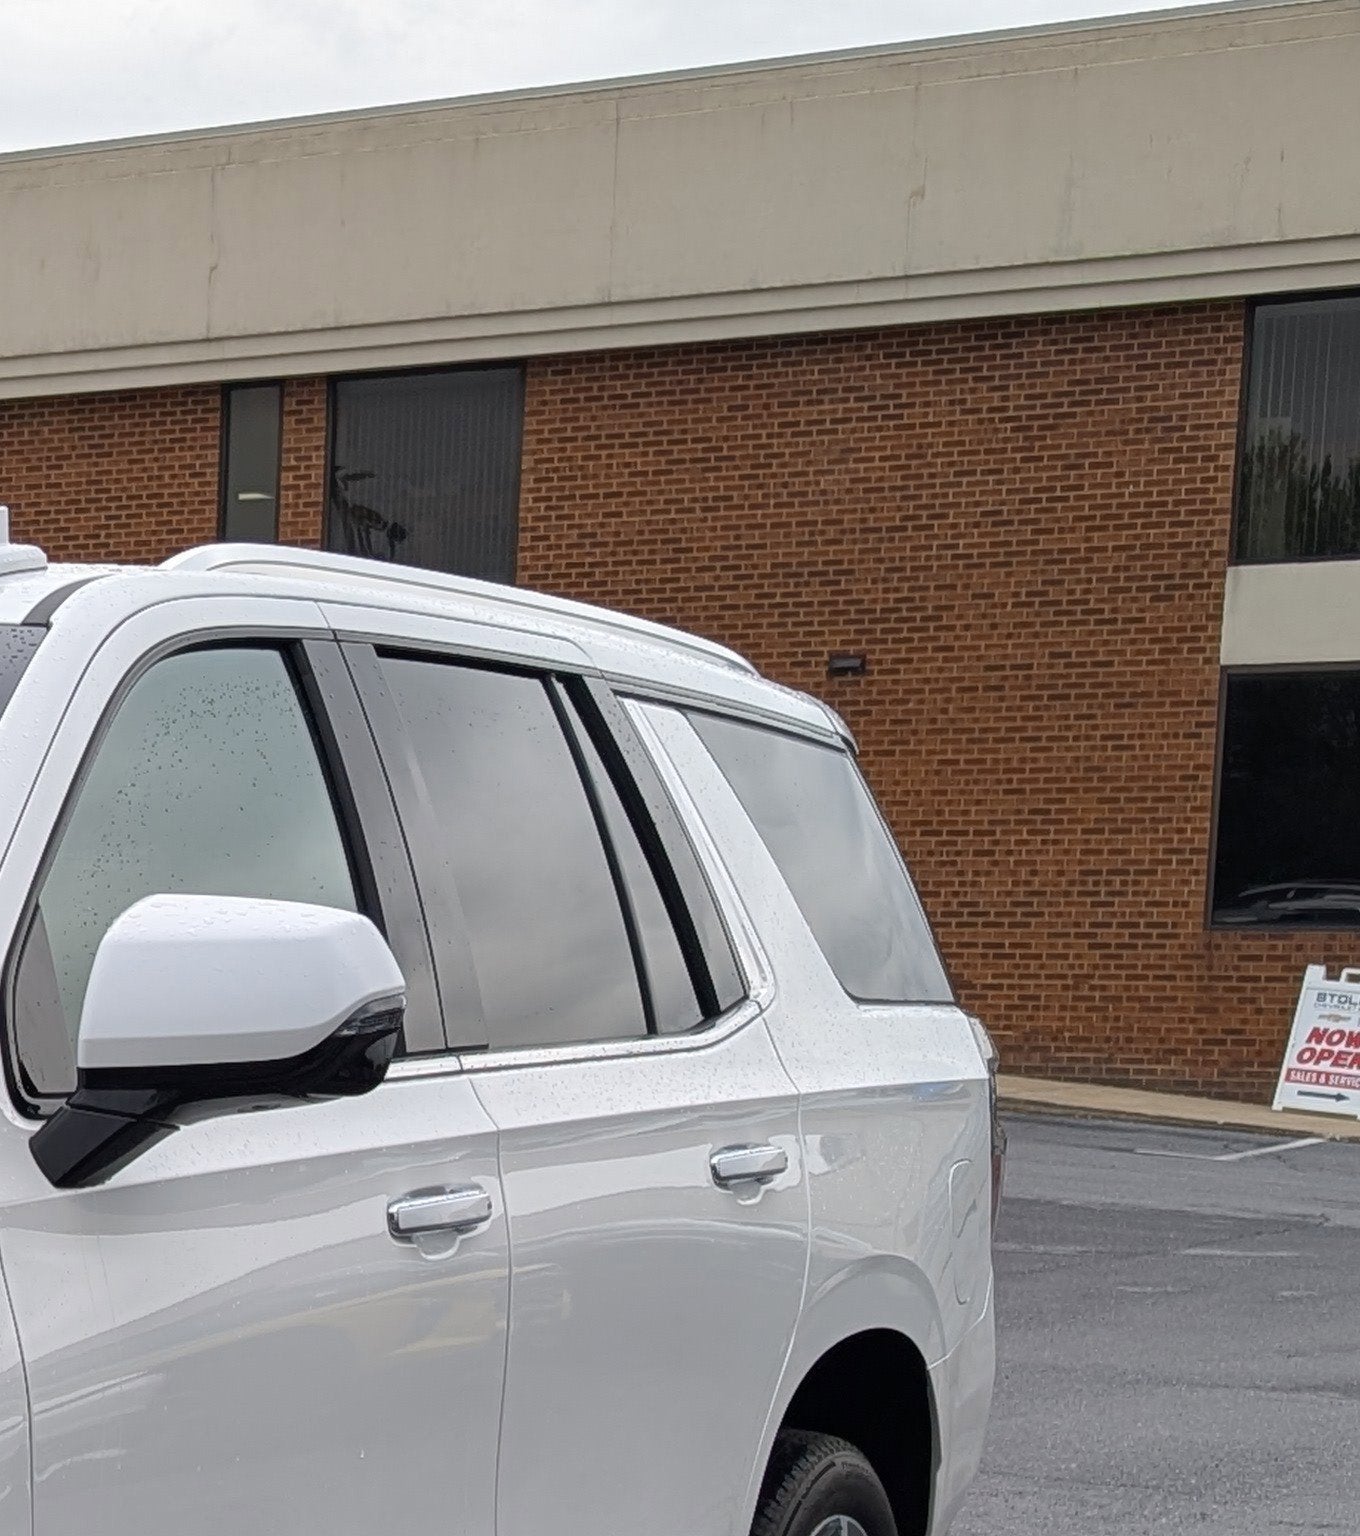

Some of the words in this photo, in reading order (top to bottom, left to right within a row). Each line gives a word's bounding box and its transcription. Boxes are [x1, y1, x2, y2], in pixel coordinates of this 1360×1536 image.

[1316, 992, 1360, 1007] STOL
[1290, 1070, 1317, 1083] SALES
[1328, 1073, 1360, 1088] SERVIC
